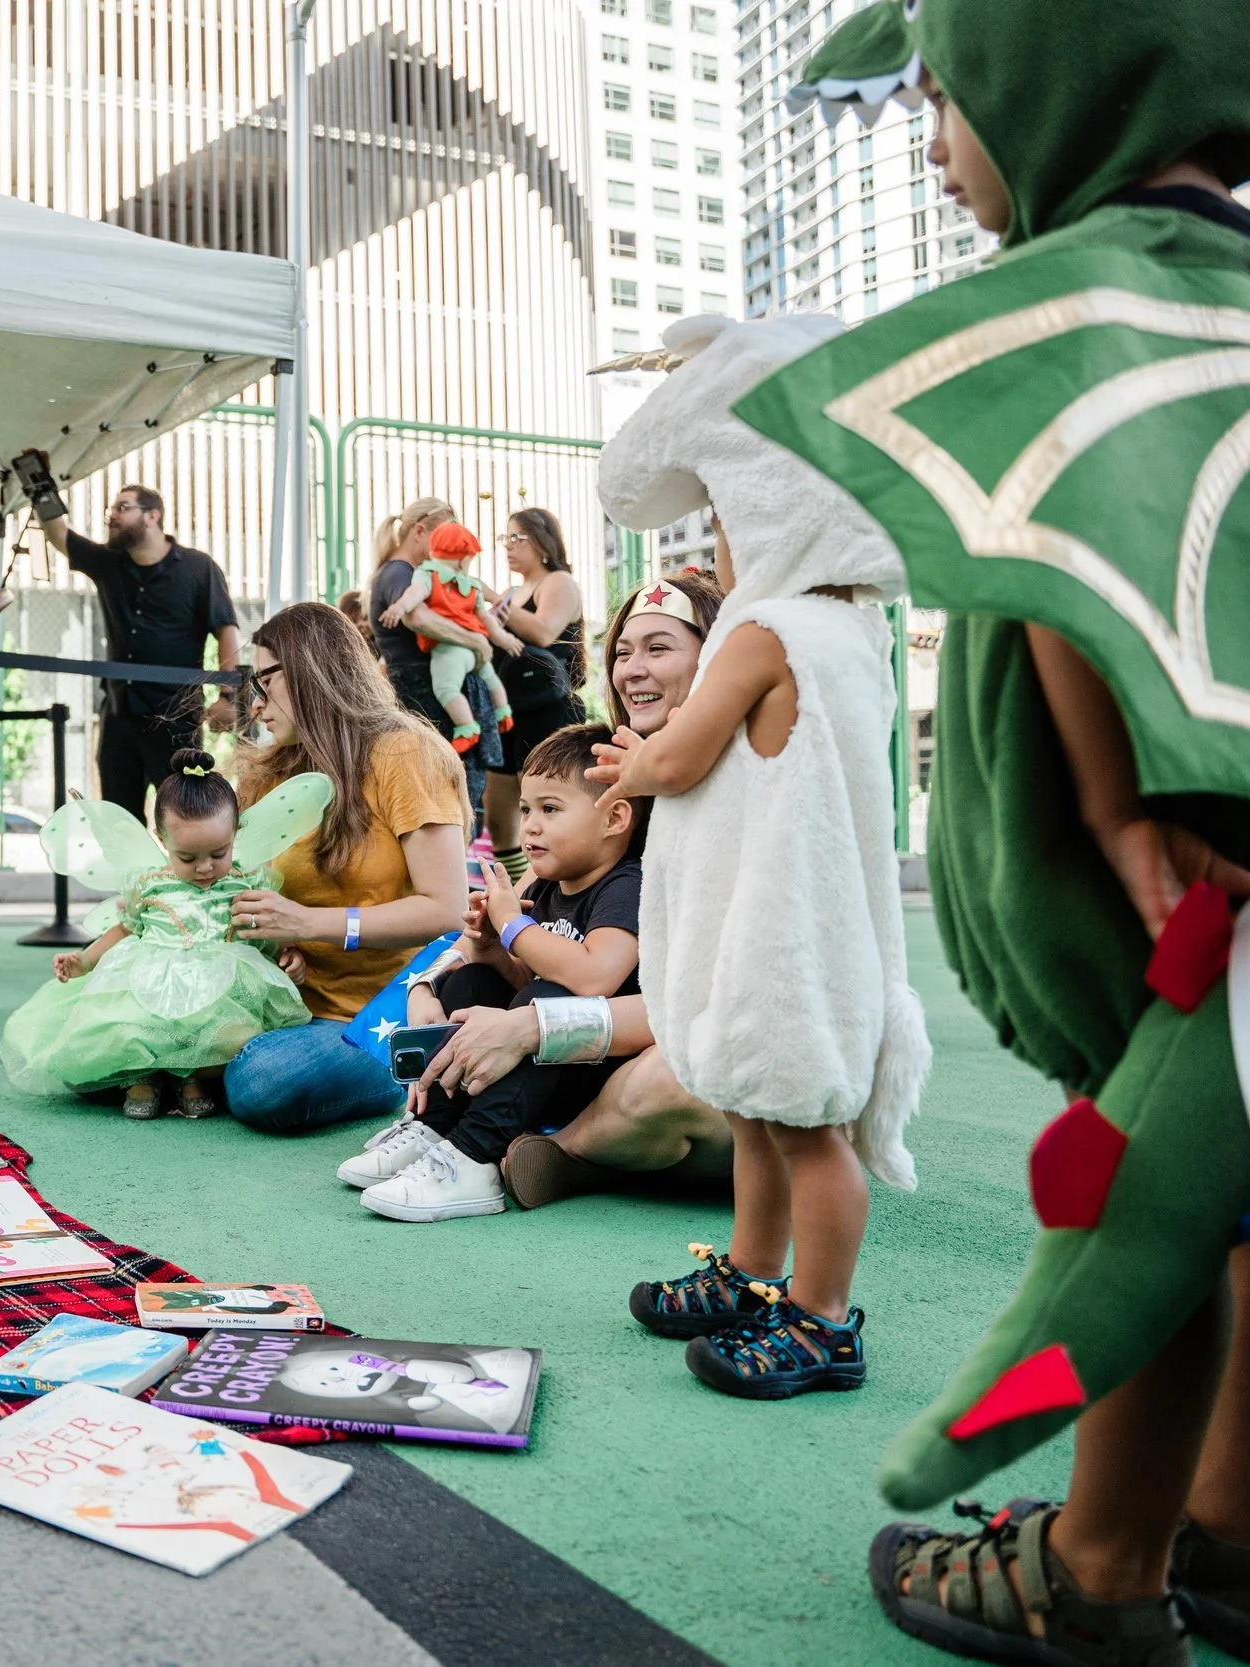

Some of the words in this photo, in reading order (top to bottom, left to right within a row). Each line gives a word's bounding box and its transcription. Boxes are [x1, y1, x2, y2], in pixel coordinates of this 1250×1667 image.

[170, 1333, 255, 1398] CREEPY
[218, 1335, 300, 1403] CRAYON!
[7, 1427, 39, 1444] THE
[274, 1414, 328, 1428] CREEPY
[333, 1419, 390, 1434] CRAYON!
[13, 1420, 143, 1488] DOLLS
